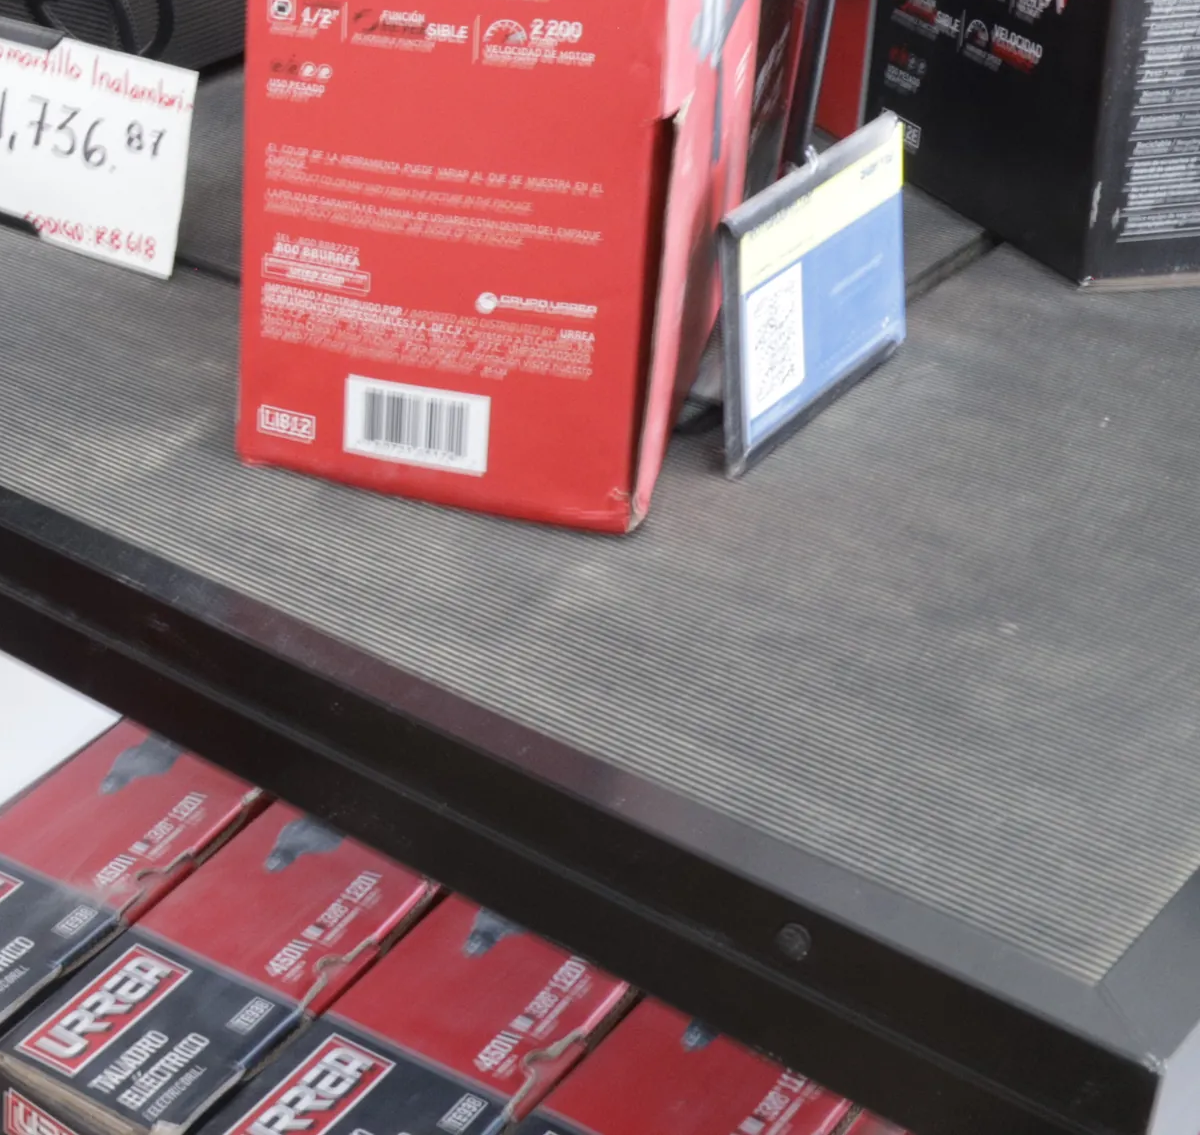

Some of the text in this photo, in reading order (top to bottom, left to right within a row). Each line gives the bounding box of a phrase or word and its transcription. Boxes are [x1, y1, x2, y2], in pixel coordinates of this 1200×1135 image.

[991, 23, 1044, 61] VELOCIDAD
[559, 328, 596, 342] URREA
[33, 955, 179, 1060] URREA
[86, 1029, 170, 1095] TALADRO
[245, 1044, 378, 1135] RREA
